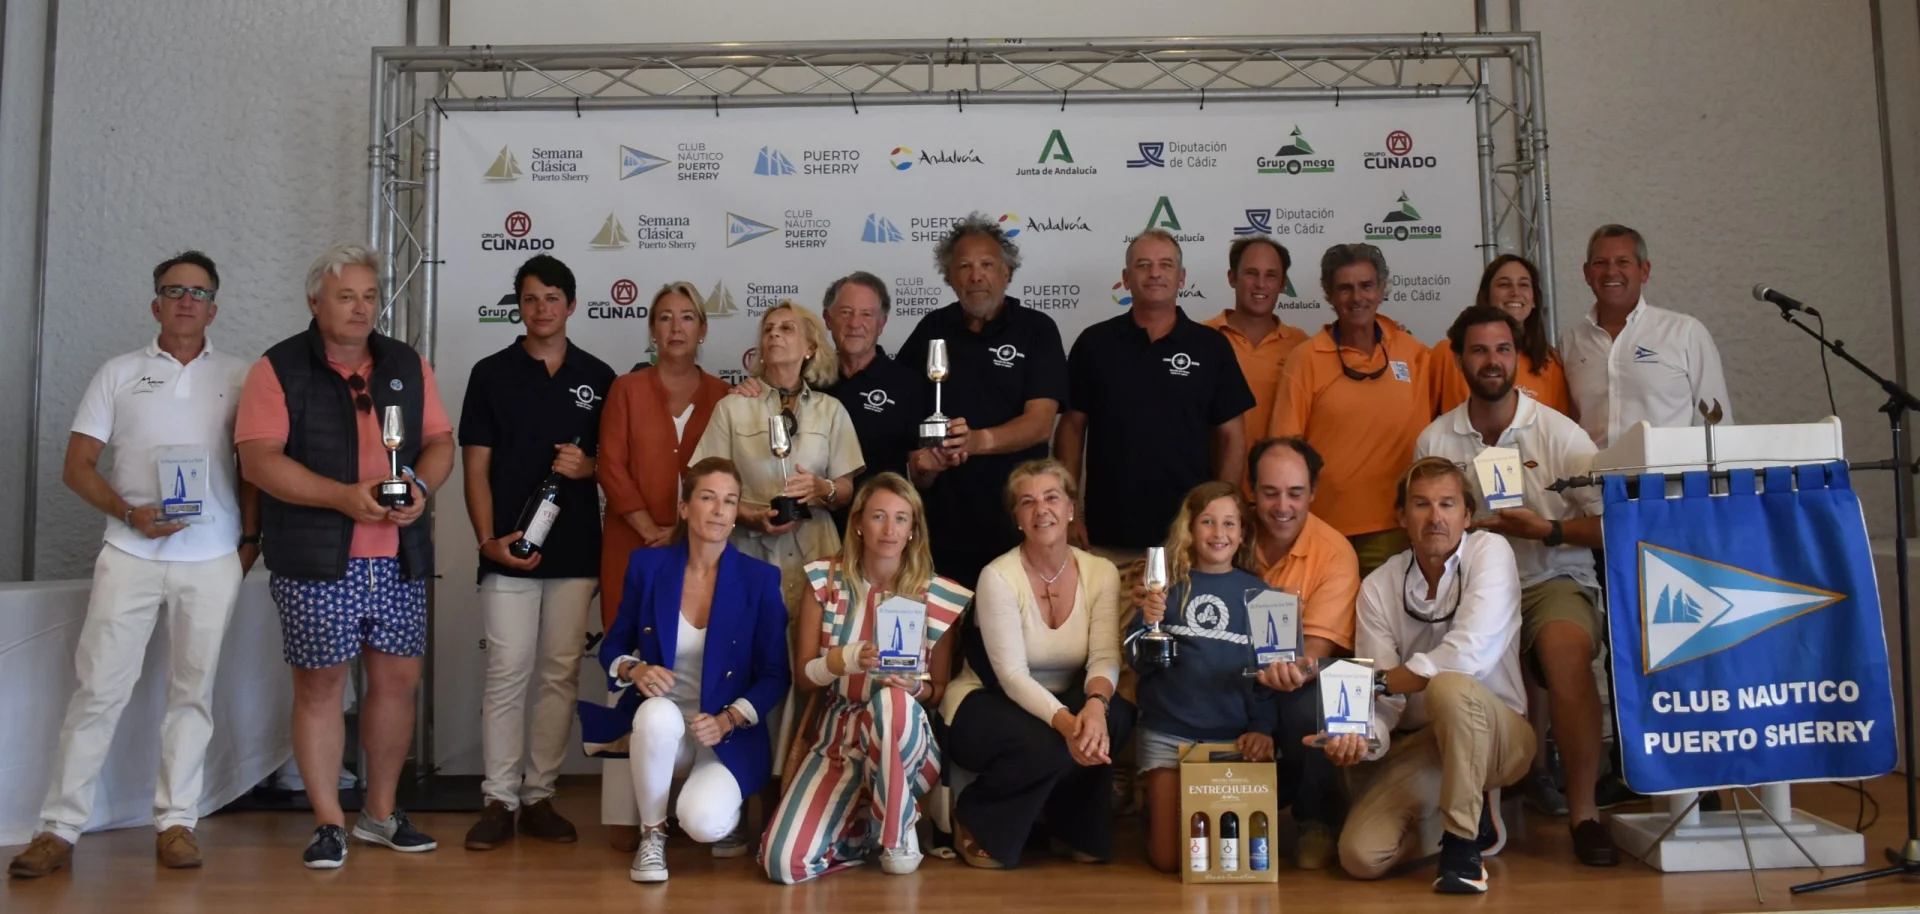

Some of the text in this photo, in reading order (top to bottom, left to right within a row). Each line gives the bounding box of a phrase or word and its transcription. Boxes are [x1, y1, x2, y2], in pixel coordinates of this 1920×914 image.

[678, 143, 706, 151] CLUB
[1169, 141, 1227, 154] Diputación
[532, 148, 583, 159] Semana
[678, 151, 724, 161] NÁUTICO
[804, 150, 860, 161] PUERTO
[918, 149, 984, 165] Andalucía
[531, 160, 577, 172] Clásica
[678, 162, 720, 170] PUERTO
[1170, 156, 1217, 167] de Cádiz
[804, 163, 859, 174] SHERRY
[1042, 167, 1053, 175] de
[1054, 166, 1097, 175] Andalucía
[532, 173, 590, 183] Puerto Sherry
[678, 172, 719, 180] SHERRY
[785, 209, 813, 218] CLUB
[1276, 207, 1334, 220] Diputación
[638, 214, 690, 226] Semana
[785, 218, 831, 228] NÁUTICO
[1025, 216, 1092, 232] Andalucía
[638, 227, 684, 240] Clásica
[785, 229, 828, 238] PUERTO
[1277, 222, 1324, 235] de Cádiz
[911, 231, 949, 242] SHER
[639, 240, 697, 250] Puerto Sherry
[785, 239, 827, 248] SHERRY
[895, 277, 924, 286] CLUB
[1393, 275, 1451, 287] Diputación
[747, 282, 799, 294] Semana
[1022, 285, 1080, 296] PUERTO
[1394, 289, 1441, 301] de Cádiz
[896, 297, 939, 306] PUERTO
[1024, 298, 1080, 310] SHERRY
[1277, 300, 1320, 309] Andalucía
[588, 307, 648, 319] CUNAD
[1652, 680, 1860, 714] CLUB NAUTICO
[1644, 719, 1876, 755] PUERTO SHERRY
[1189, 784, 1269, 795] ENTRECHUELOS
